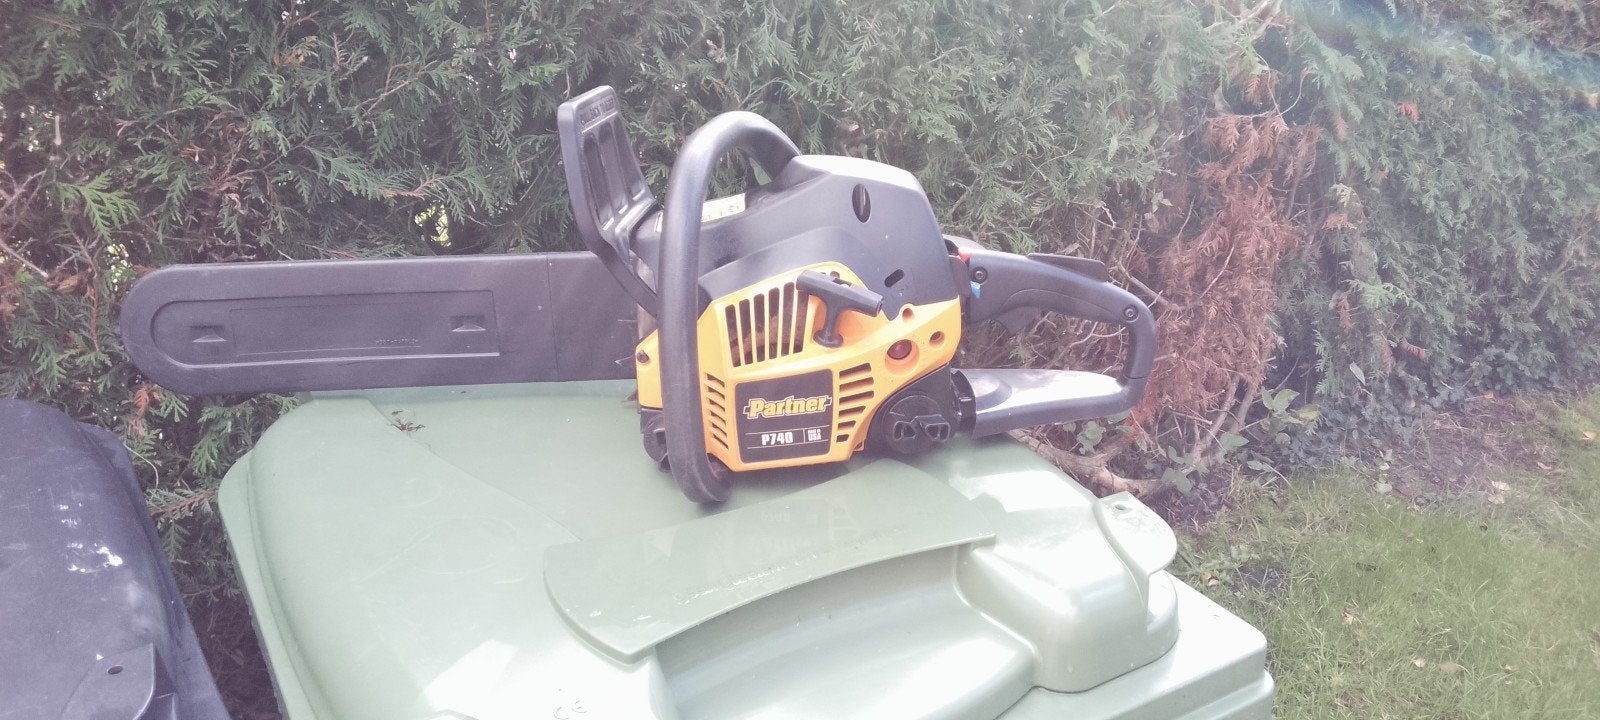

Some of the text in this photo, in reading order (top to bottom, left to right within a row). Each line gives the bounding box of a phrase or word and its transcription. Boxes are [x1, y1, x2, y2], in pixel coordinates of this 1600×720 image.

[747, 395, 829, 419] Partner
[761, 432, 793, 446] P740
[808, 433, 822, 442] USA
